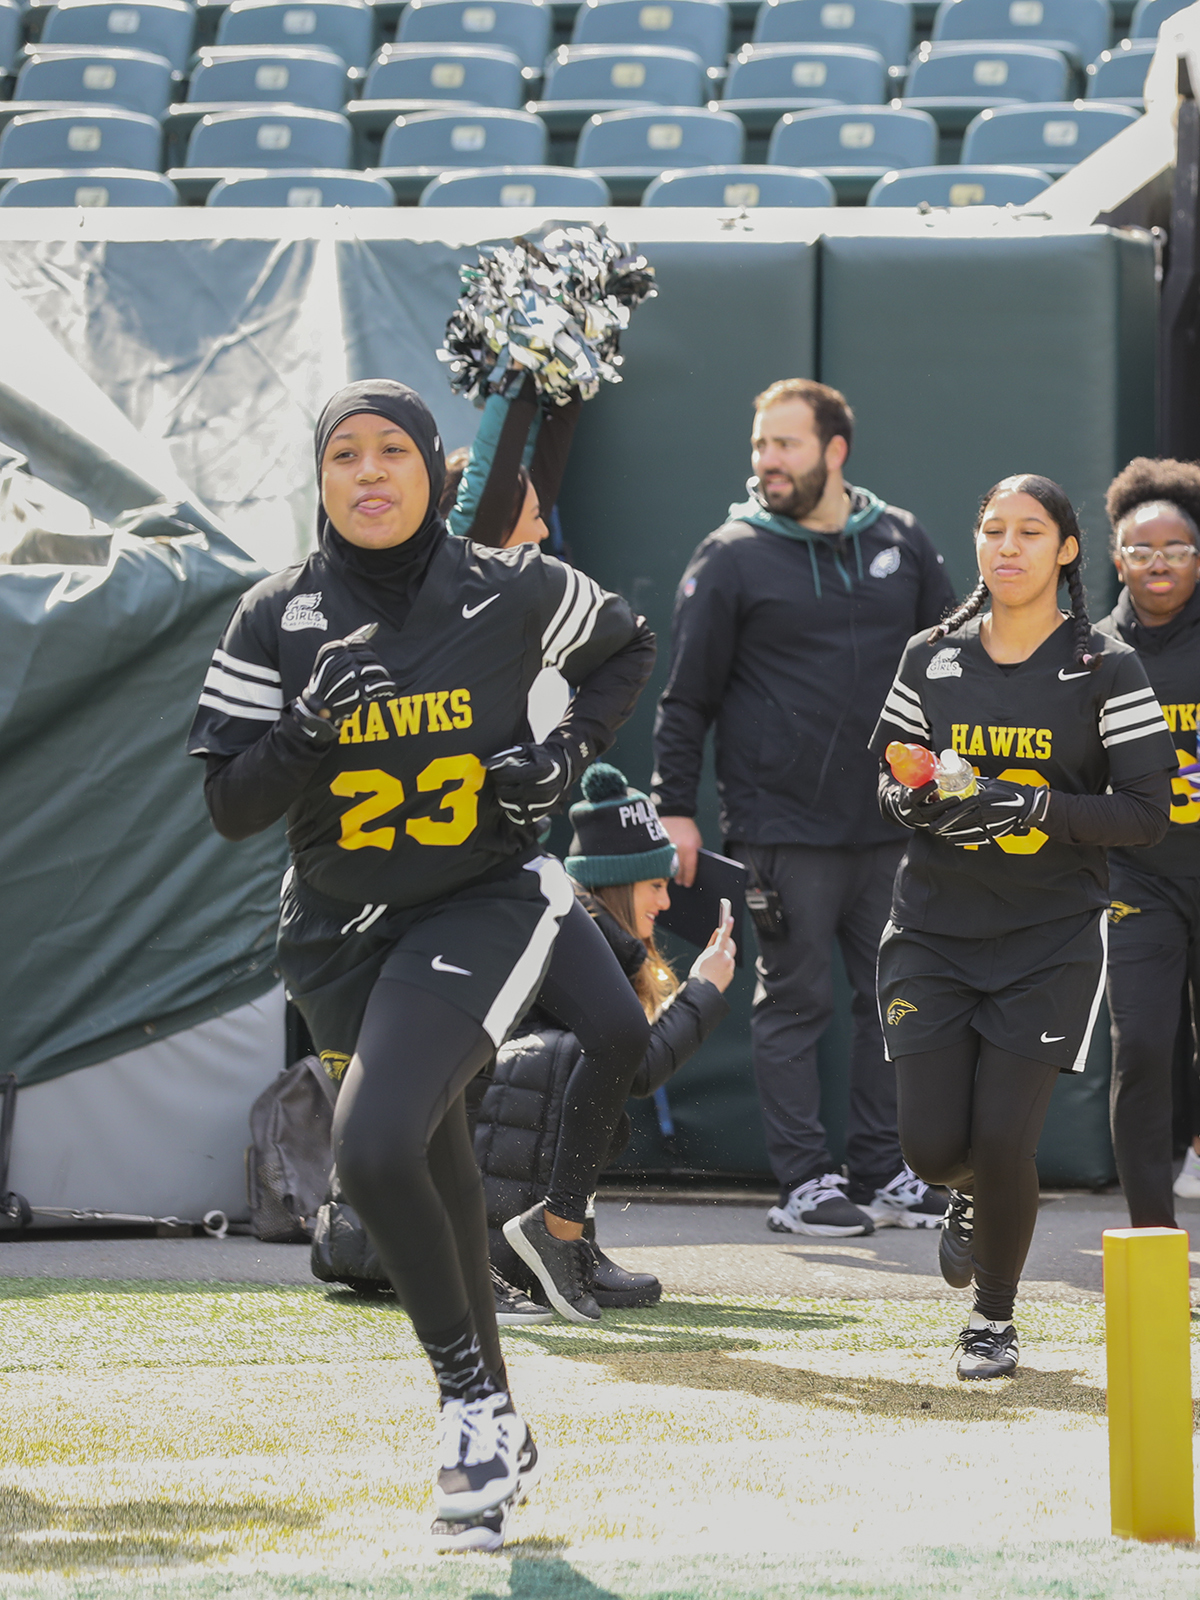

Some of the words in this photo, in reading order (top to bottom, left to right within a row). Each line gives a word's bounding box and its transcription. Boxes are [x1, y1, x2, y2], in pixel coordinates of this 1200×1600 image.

[285, 611, 322, 622] GIRLS
[930, 662, 958, 672] GIRLS
[338, 688, 473, 745] HAWKS
[951, 723, 1053, 760] HAWKS
[329, 753, 488, 851] 23
